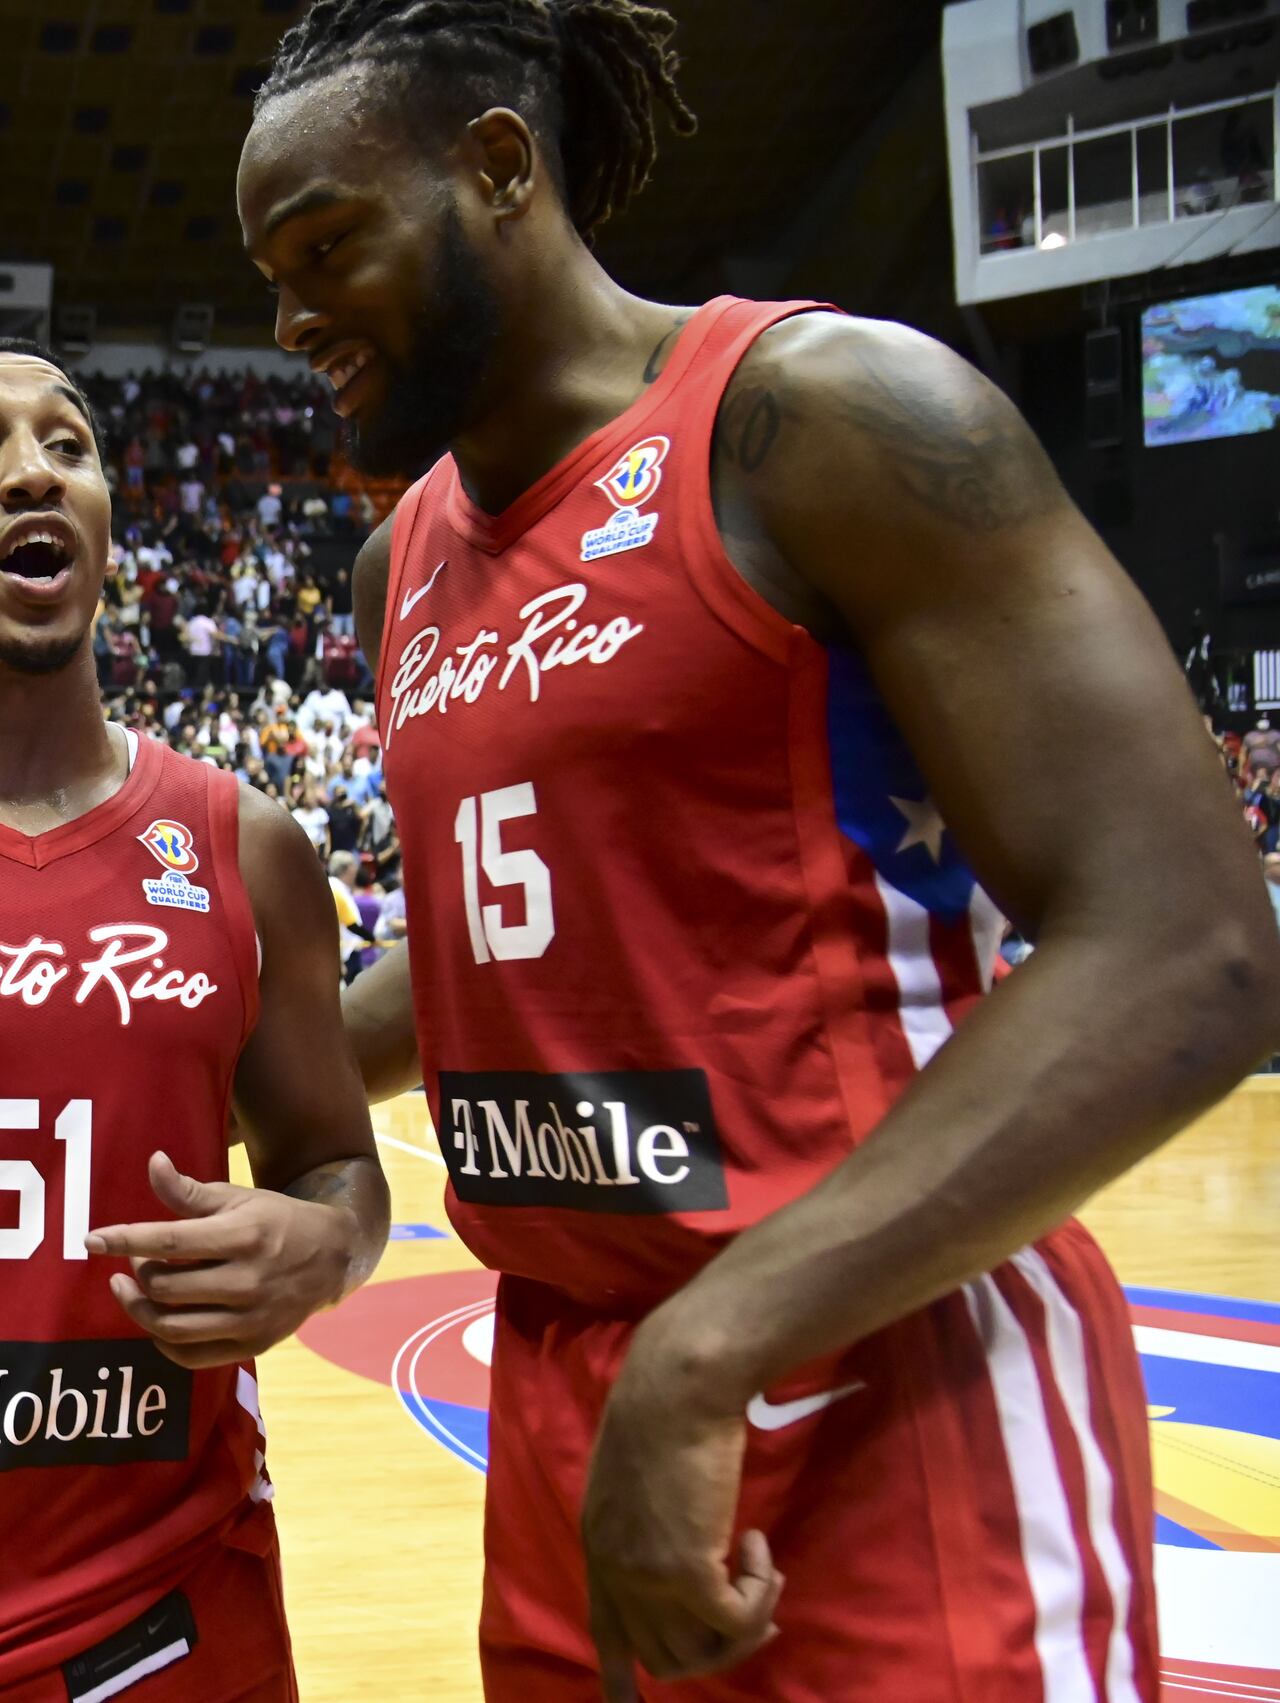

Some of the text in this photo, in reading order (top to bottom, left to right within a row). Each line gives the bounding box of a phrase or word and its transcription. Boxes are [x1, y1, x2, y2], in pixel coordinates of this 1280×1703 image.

[385, 583, 644, 751] Puerto Rico
[148, 886, 185, 897] WORLD
[187, 891, 206, 901] CUP
[151, 895, 207, 909] QUALIFIERS
[454, 781, 556, 965] 15
[75, 922, 218, 1026] Rico
